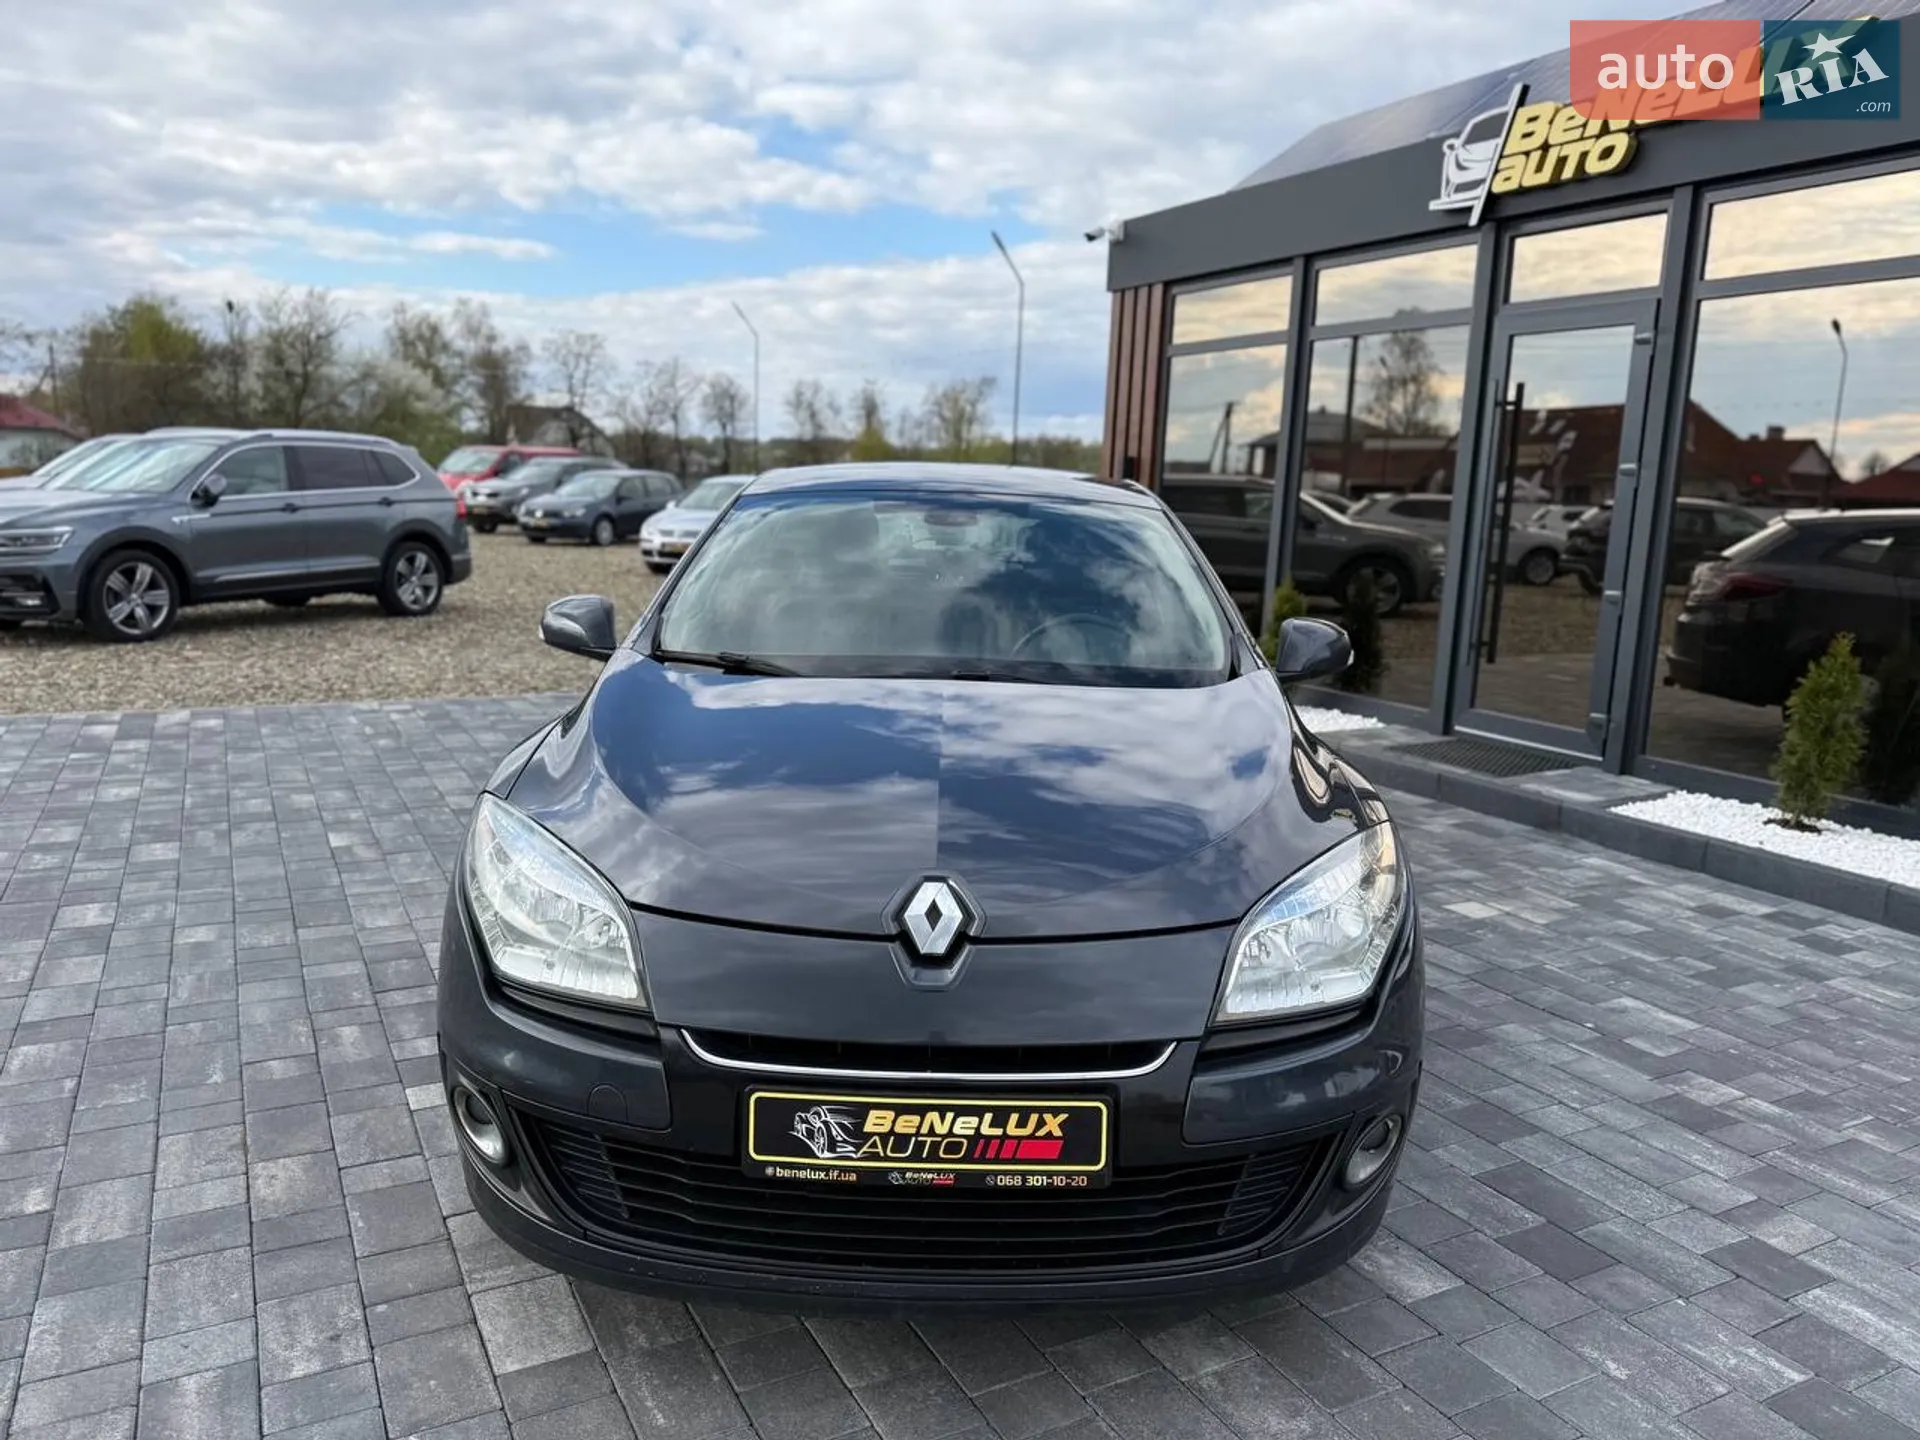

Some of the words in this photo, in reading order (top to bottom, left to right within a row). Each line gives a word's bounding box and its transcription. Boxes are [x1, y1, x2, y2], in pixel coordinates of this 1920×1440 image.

[863, 1109, 1069, 1137] BeNeLUX
[857, 1135, 968, 1159] AUTO
[776, 1165, 858, 1182] benelux.if.ua
[997, 1174, 1022, 1186] 068
[1025, 1174, 1088, 1187] 301-10-20
